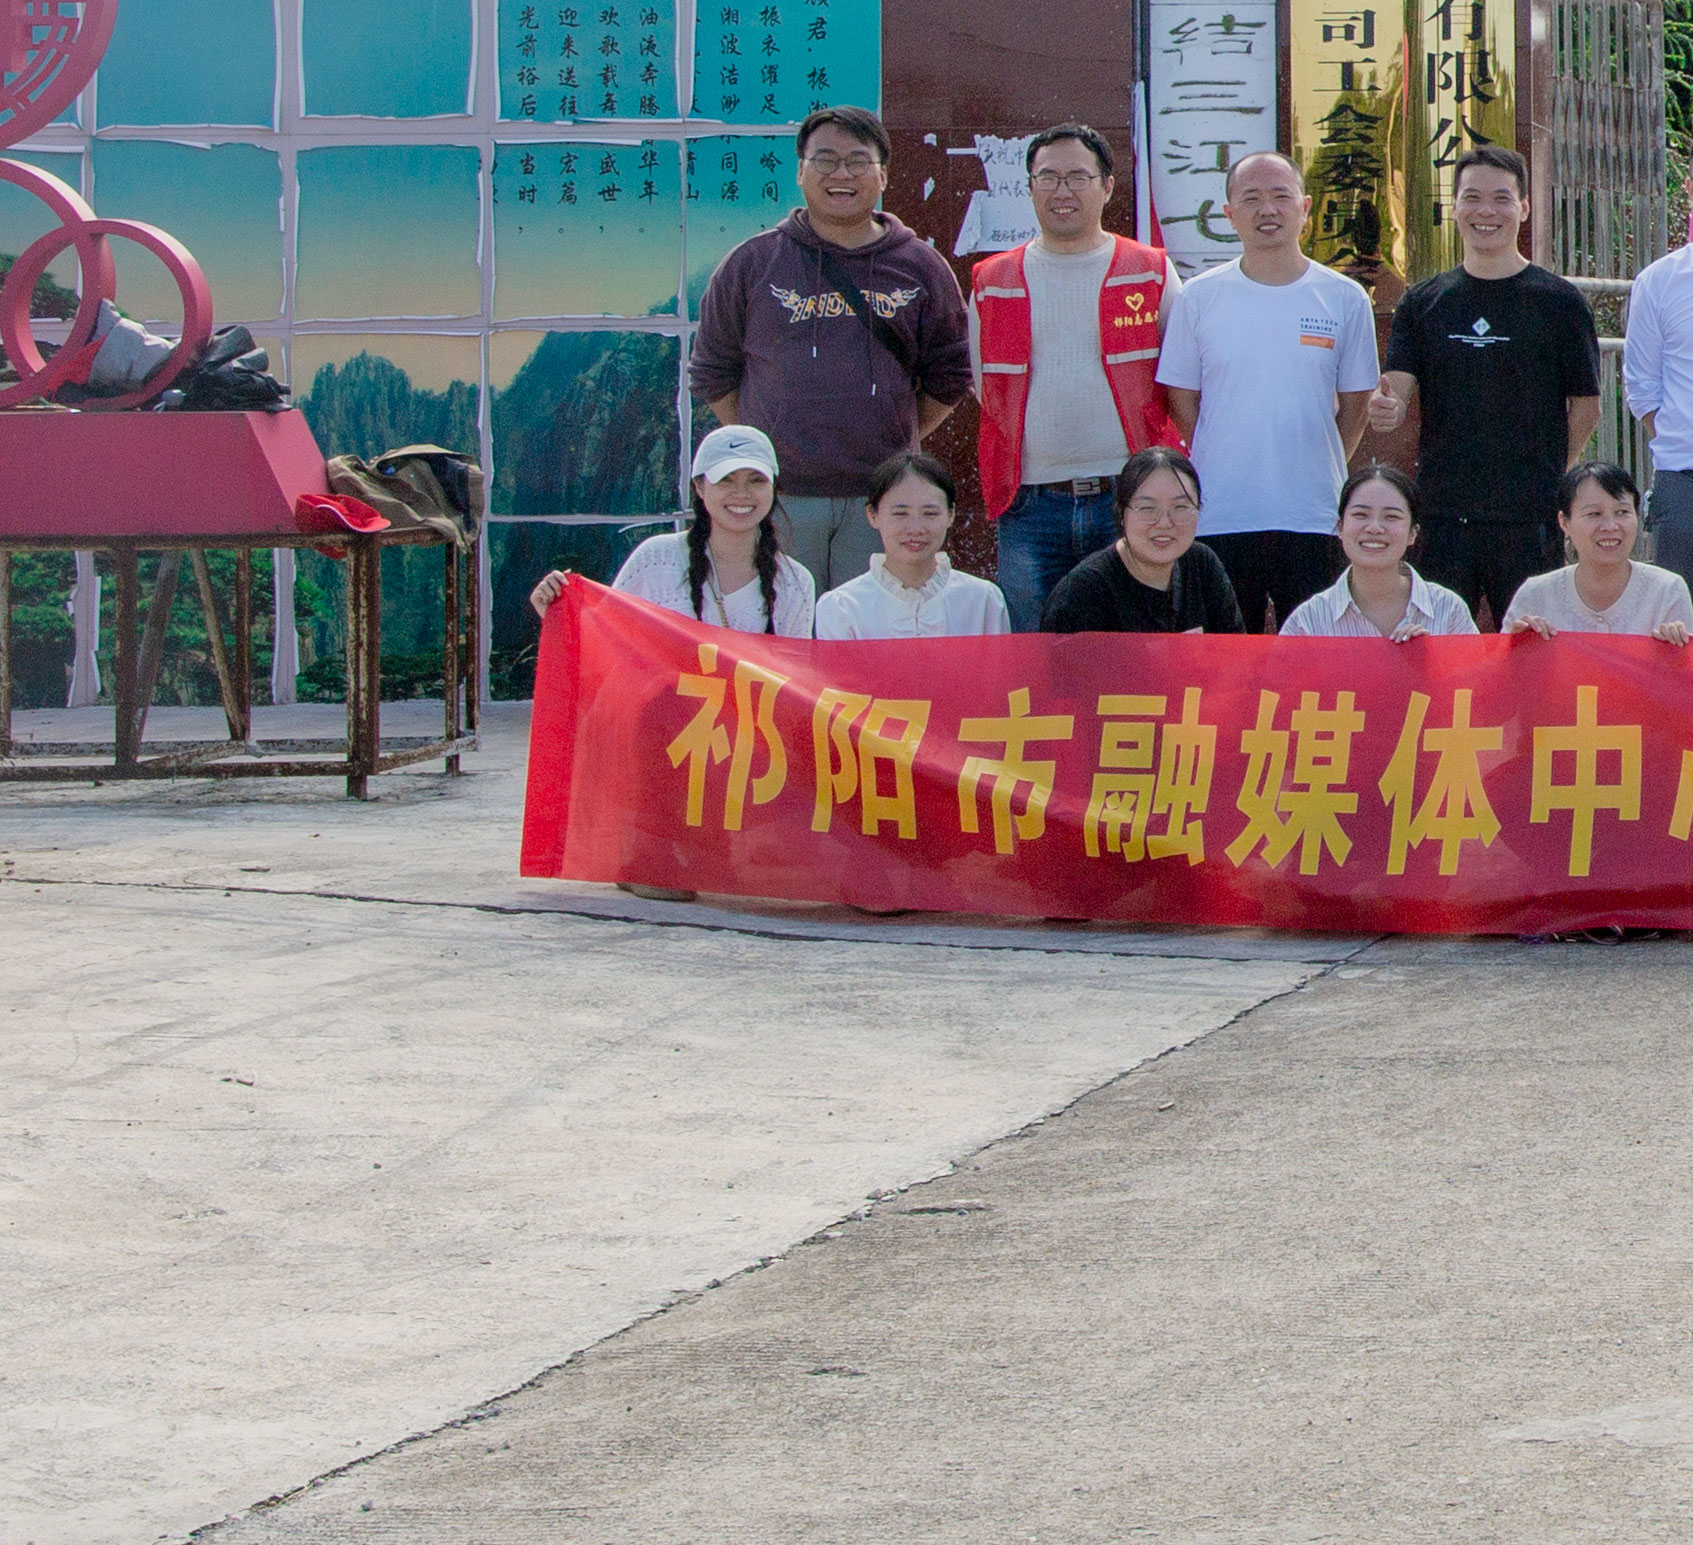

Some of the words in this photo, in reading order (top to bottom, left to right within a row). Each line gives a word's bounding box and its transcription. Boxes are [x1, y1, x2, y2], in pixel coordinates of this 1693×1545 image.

[515, 6, 540, 234] 光前裕后当时，
[557, 7, 580, 234] 迎来送往宏篇。
[597, 6, 622, 234] 欢歌载舞盛世，
[638, 7, 661, 233] 油液奔腾华年。
